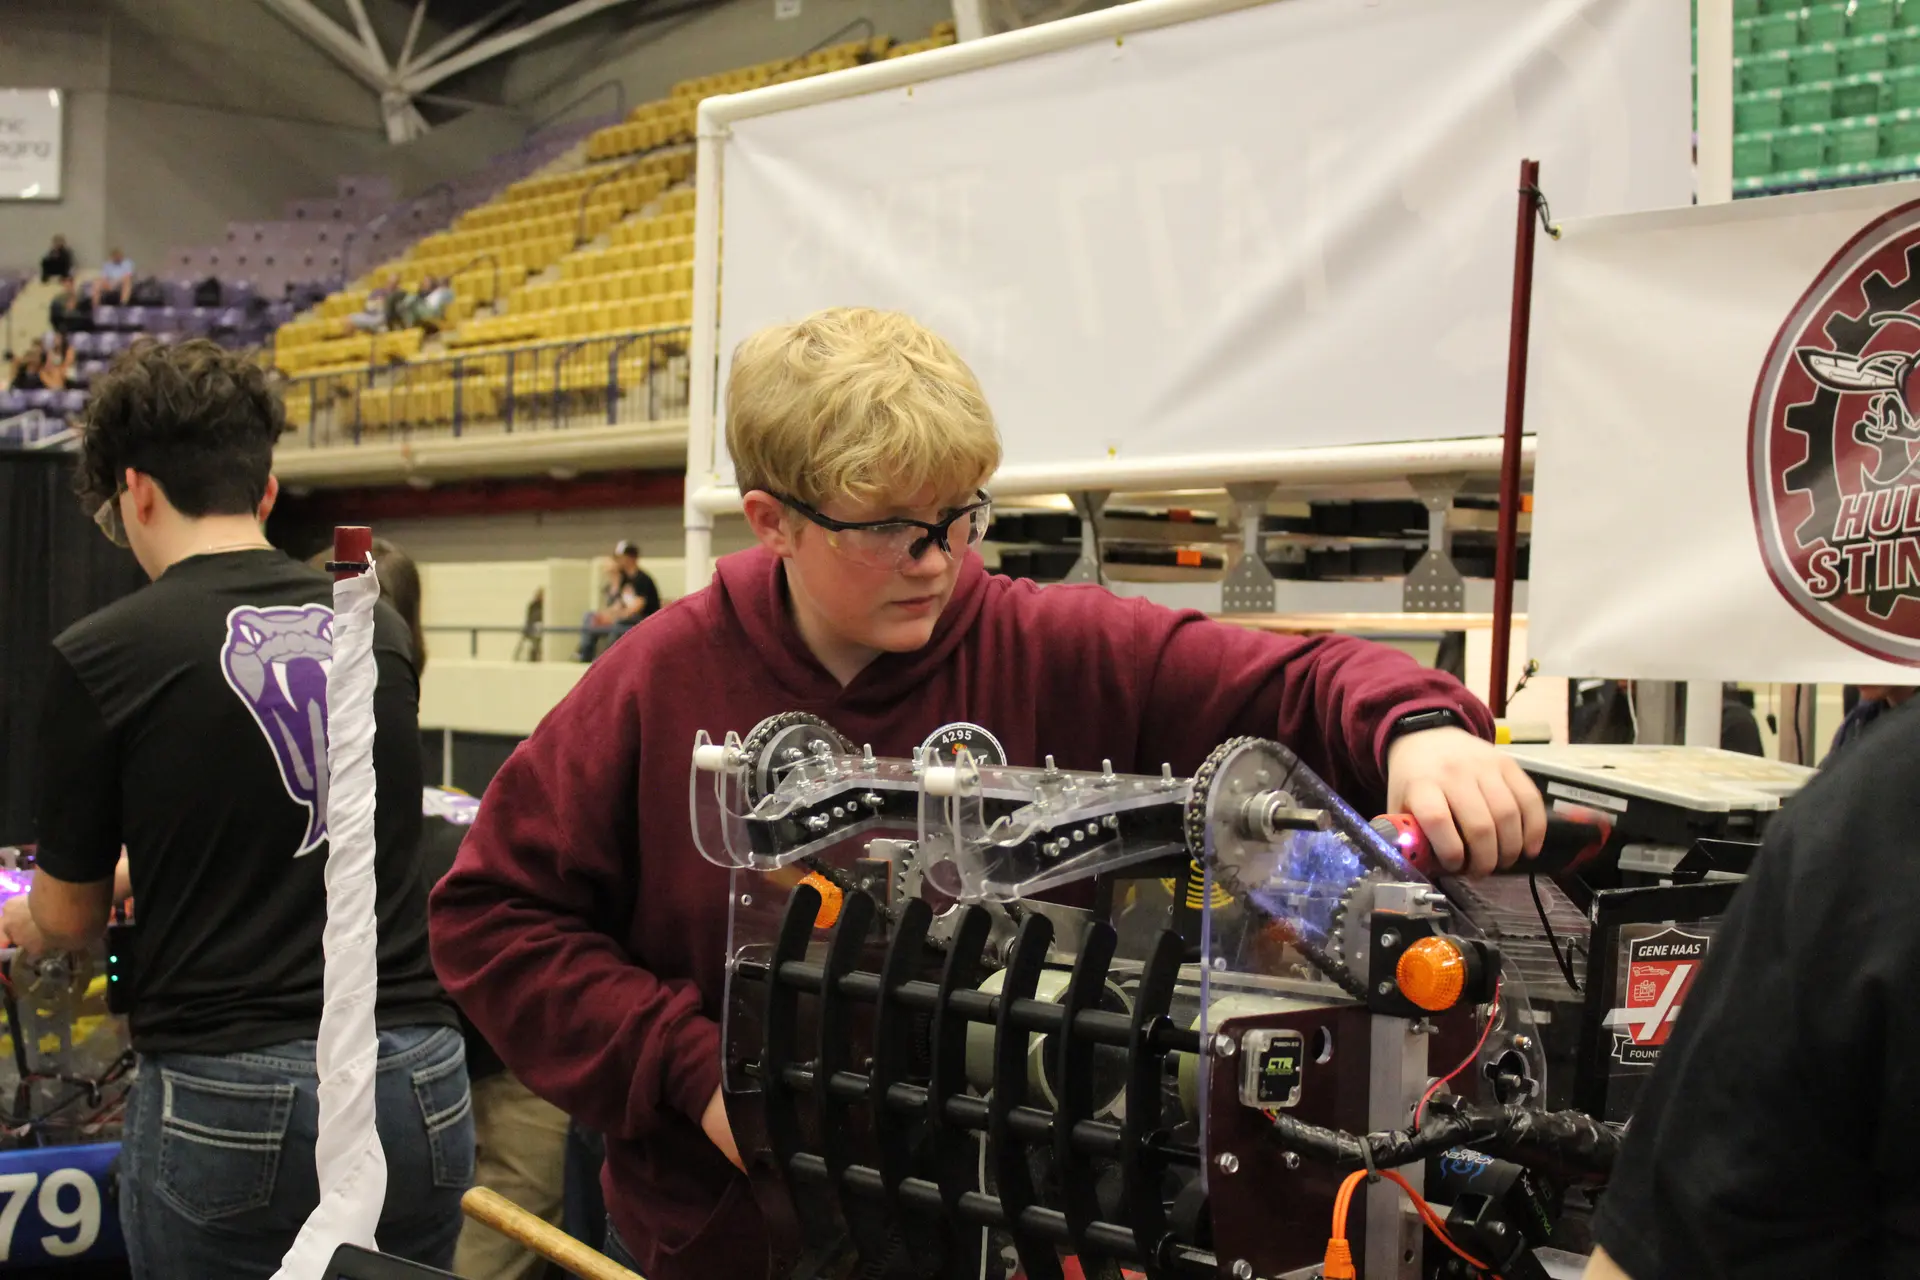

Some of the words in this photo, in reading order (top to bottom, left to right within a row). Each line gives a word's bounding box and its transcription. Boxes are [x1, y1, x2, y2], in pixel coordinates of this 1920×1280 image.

[1807, 536, 1920, 598] STIN
[942, 730, 972, 744] 4295
[1638, 945, 1669, 957] GENE
[1670, 943, 1701, 956] HAAS
[1441, 1150, 1495, 1165] KRAKEN
[0, 1168, 101, 1261] 79
